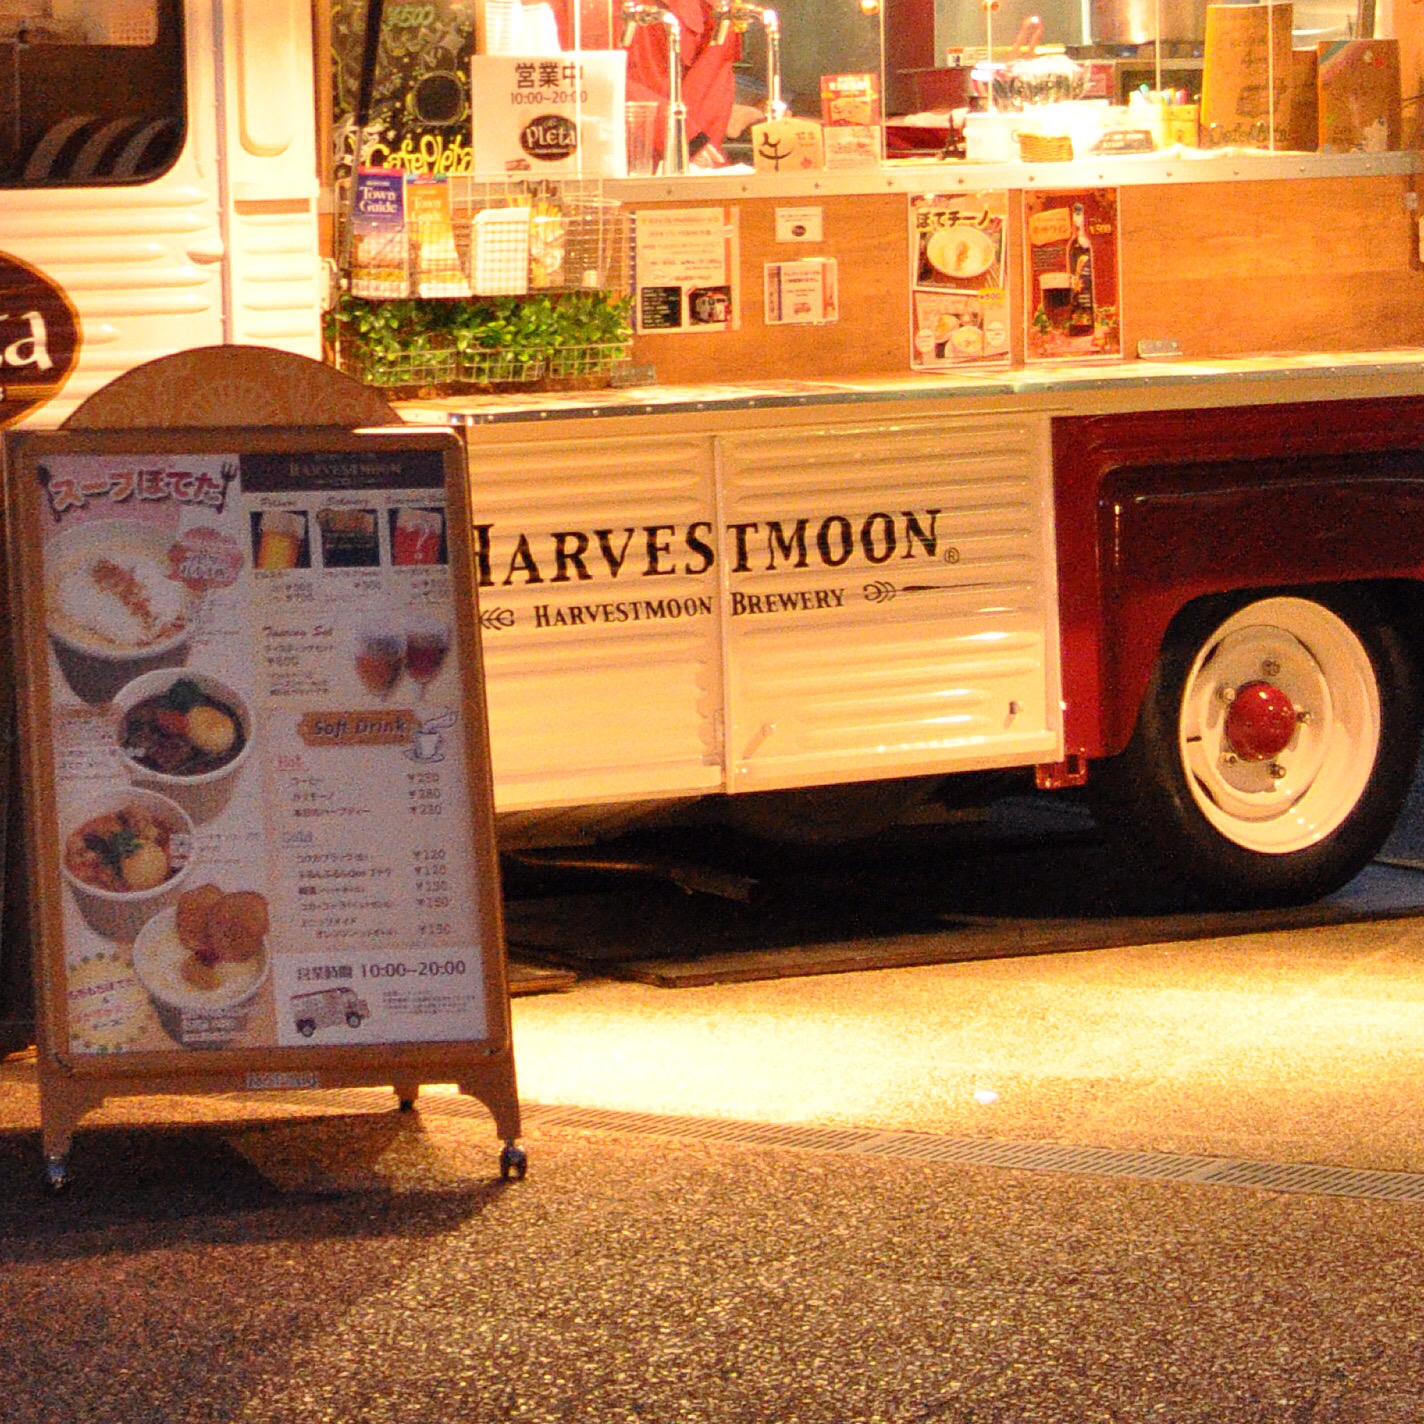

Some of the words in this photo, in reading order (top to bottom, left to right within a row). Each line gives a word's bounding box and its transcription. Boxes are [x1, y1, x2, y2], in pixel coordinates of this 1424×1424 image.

[515, 61, 583, 89] 営業中
[359, 186, 396, 200] Town
[359, 199, 398, 213] Guide
[534, 596, 713, 628] HARVESTMOON
[731, 587, 846, 617] BREWERY
